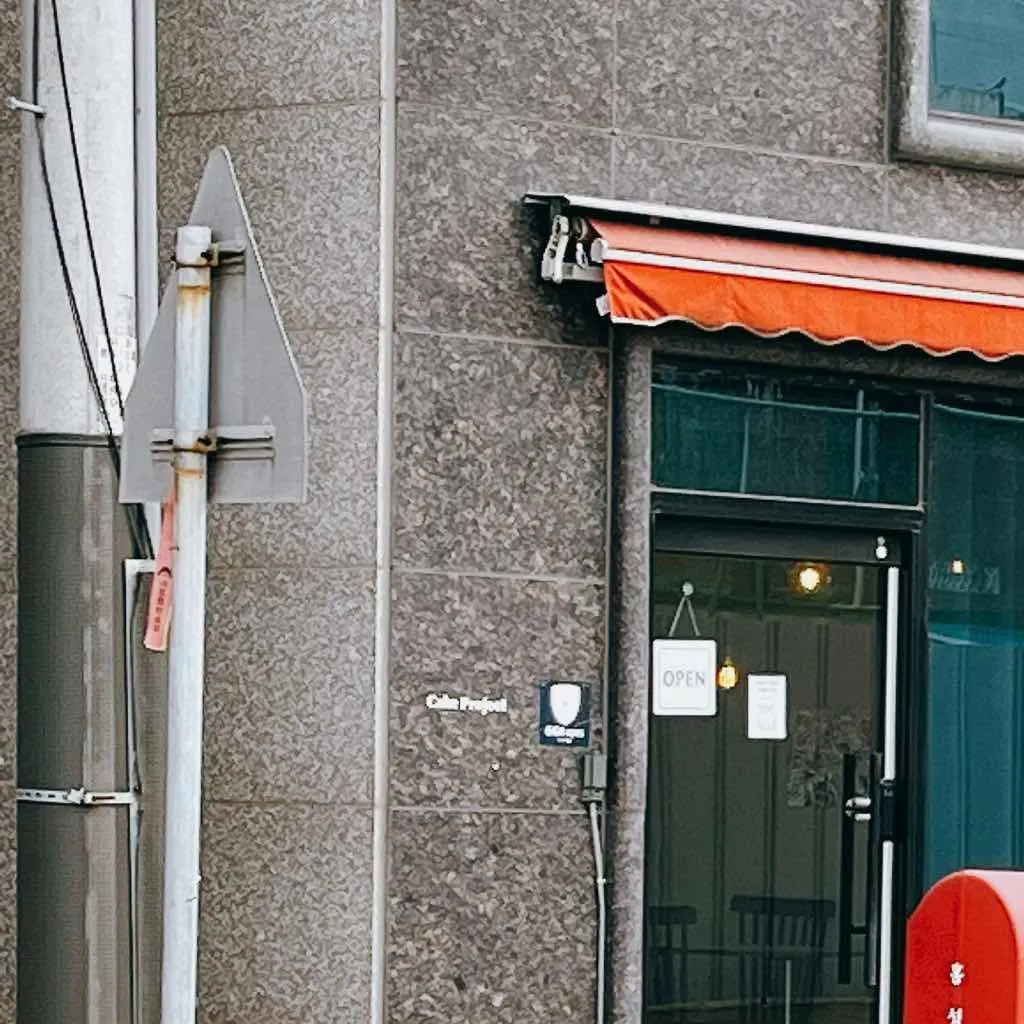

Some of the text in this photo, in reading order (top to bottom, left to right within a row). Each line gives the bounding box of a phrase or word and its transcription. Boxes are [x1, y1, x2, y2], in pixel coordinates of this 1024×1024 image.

[663, 670, 706, 688] OPEN
[425, 693, 508, 715] Cake Project
